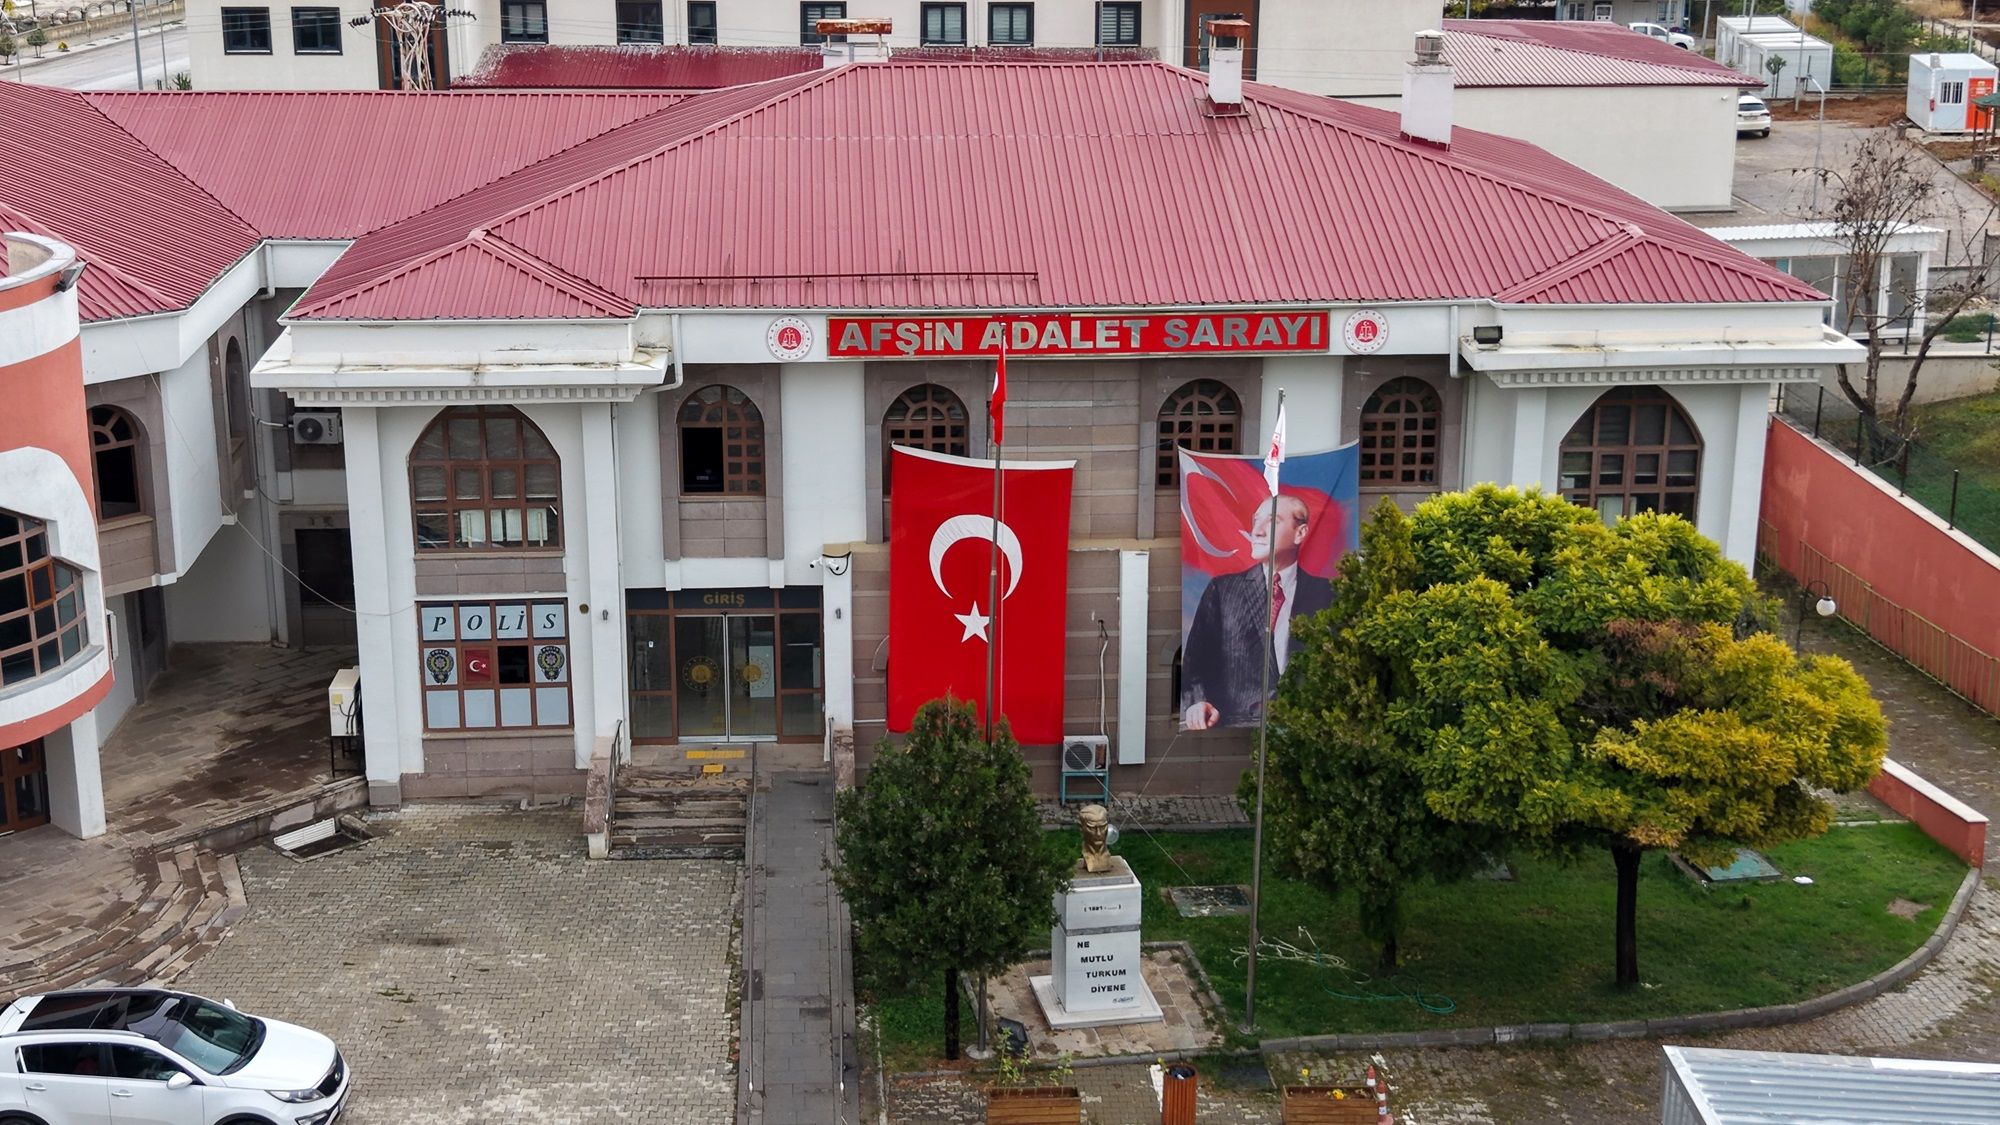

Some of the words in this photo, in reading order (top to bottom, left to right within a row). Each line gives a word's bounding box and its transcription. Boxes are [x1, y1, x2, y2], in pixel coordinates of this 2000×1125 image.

[979, 319, 1149, 350] ADALET
[1163, 316, 1320, 348] SARAYI
[703, 592, 745, 607] GİRİŞ
[432, 611, 557, 632] POLİS
[1080, 954, 1114, 963] MUTLU
[1091, 984, 1126, 993] DİYENE
